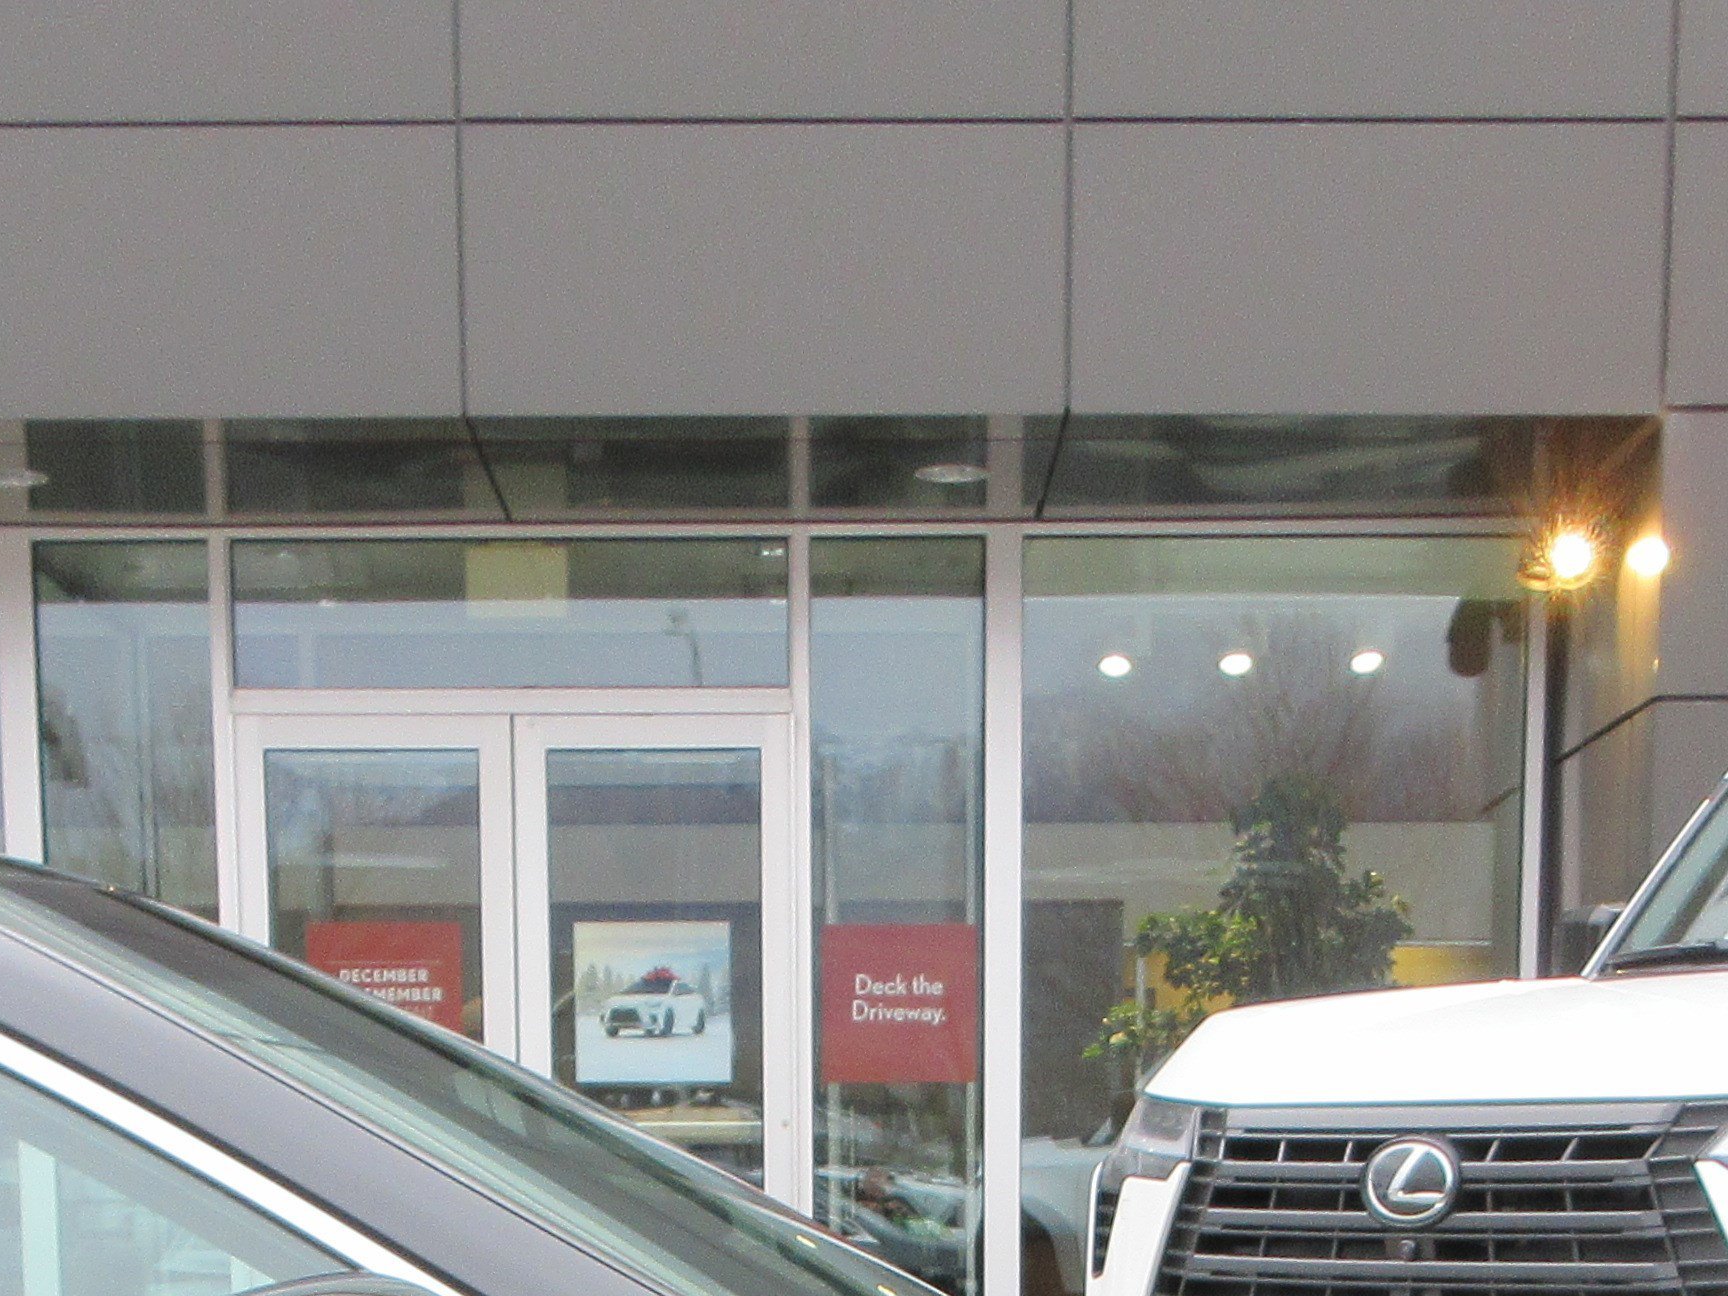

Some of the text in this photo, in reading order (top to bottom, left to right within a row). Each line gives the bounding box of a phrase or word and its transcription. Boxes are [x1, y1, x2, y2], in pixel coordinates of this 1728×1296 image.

[338, 968, 429, 983] DECEMBER
[855, 973, 943, 995] Deck the
[366, 987, 443, 1001] MEMBER
[852, 999, 947, 1025] Driveway.
